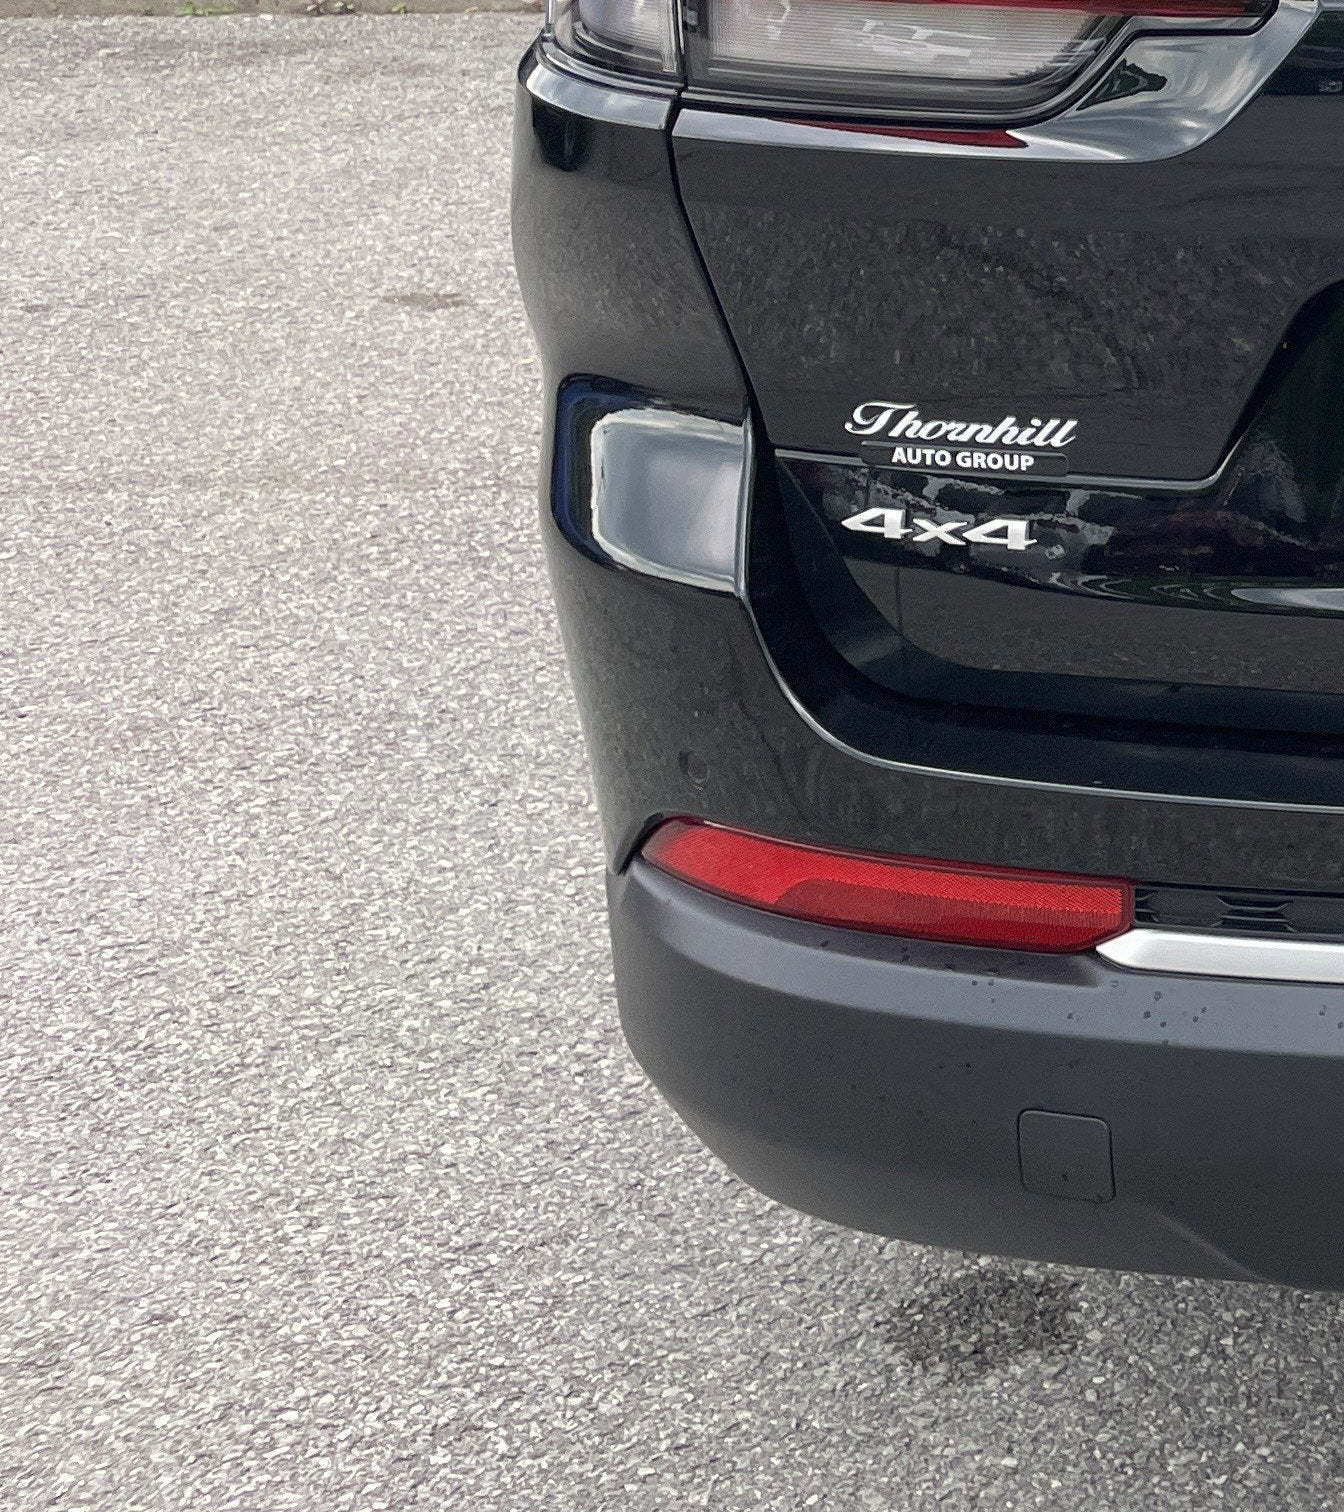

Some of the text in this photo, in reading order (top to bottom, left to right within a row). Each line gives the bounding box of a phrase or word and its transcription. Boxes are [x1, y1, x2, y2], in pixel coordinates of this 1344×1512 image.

[844, 400, 1079, 448] Thornhill
[891, 446, 1036, 472] AUTO GROUP
